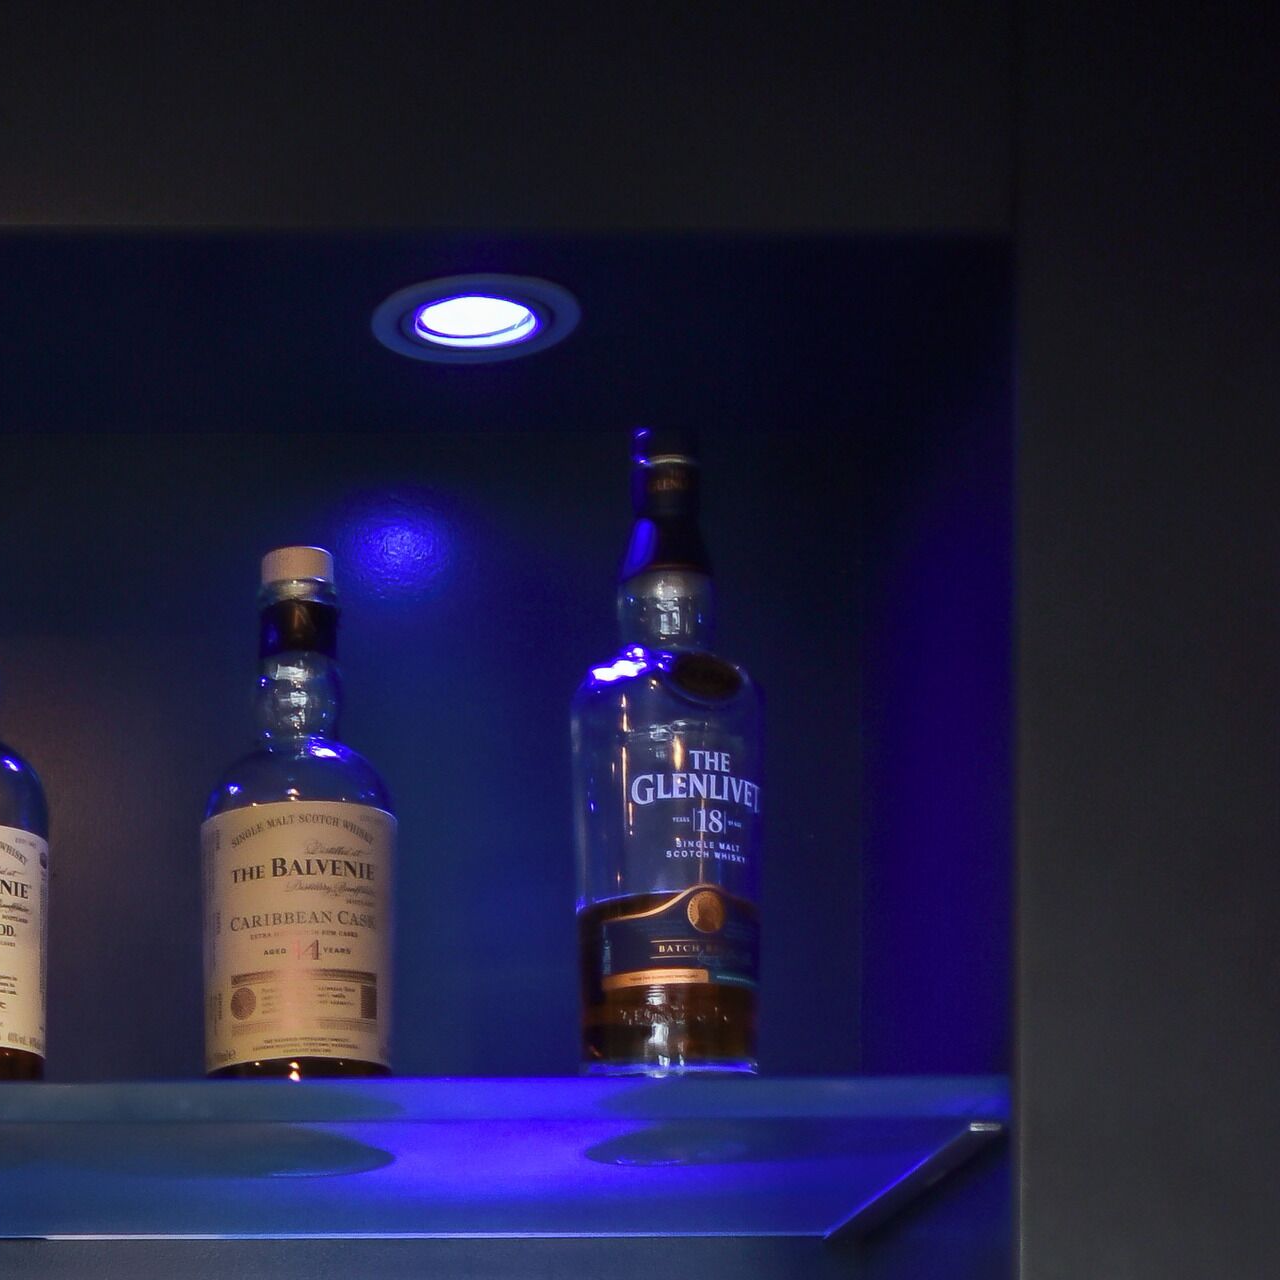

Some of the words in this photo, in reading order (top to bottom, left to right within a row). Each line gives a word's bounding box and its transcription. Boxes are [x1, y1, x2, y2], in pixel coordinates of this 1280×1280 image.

[690, 750, 731, 773] THE
[631, 773, 761, 813] GLENLIVET
[230, 823, 264, 849] SINGLE
[267, 815, 294, 830] MALT
[298, 814, 339, 828] SCOTCH
[698, 809, 724, 833] 18
[0, 841, 28, 866] WHISKY
[665, 850, 710, 859] SCOTCH
[675, 840, 715, 849] SINGLE
[719, 842, 740, 853] MALT
[232, 865, 265, 884] THE
[271, 857, 375, 881] BALVENIE
[230, 911, 333, 932] CARIBBEAN
[337, 910, 376, 930] CASK
[323, 947, 352, 955] YEARS
[658, 943, 700, 953] BATCH
